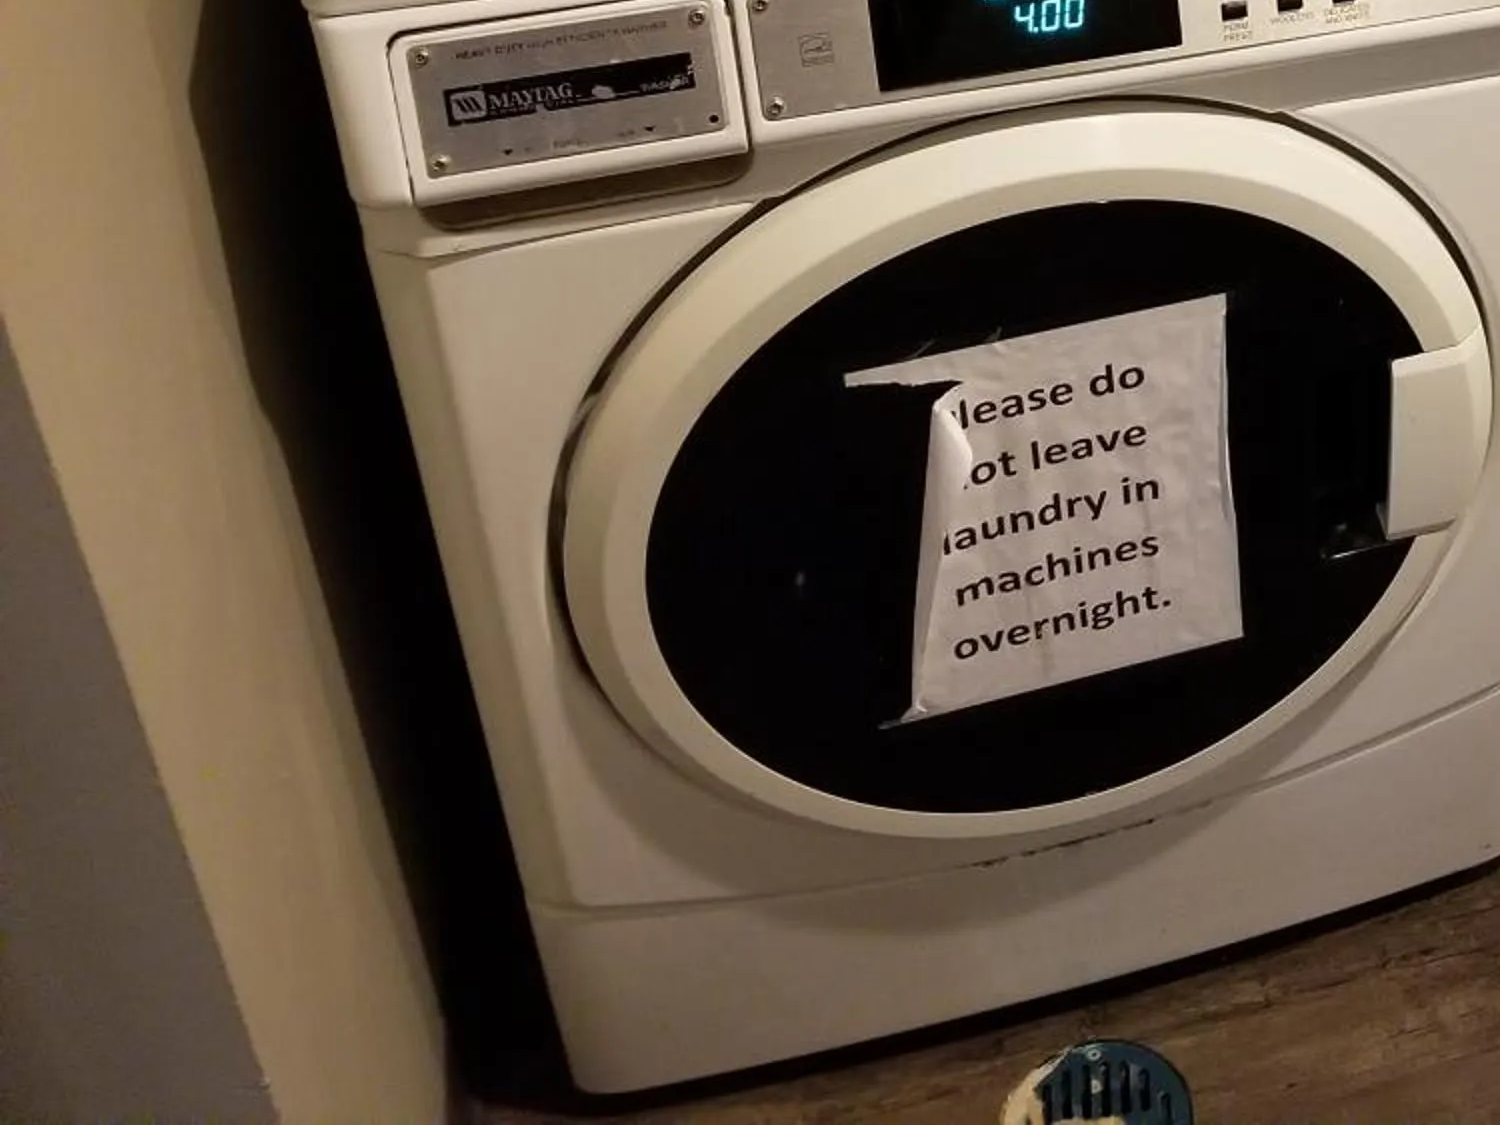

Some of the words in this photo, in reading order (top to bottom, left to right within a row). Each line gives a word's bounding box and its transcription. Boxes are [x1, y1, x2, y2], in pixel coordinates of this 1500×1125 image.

[487, 83, 574, 110] MAYTAG
[950, 381, 1074, 430] lease
[1089, 364, 1146, 397] do
[963, 451, 1018, 490] ot
[1031, 424, 1148, 470] leave
[942, 489, 1108, 556] laundry
[1122, 477, 1160, 505] in
[956, 535, 1160, 608] machines
[953, 585, 1172, 661] overnight.
